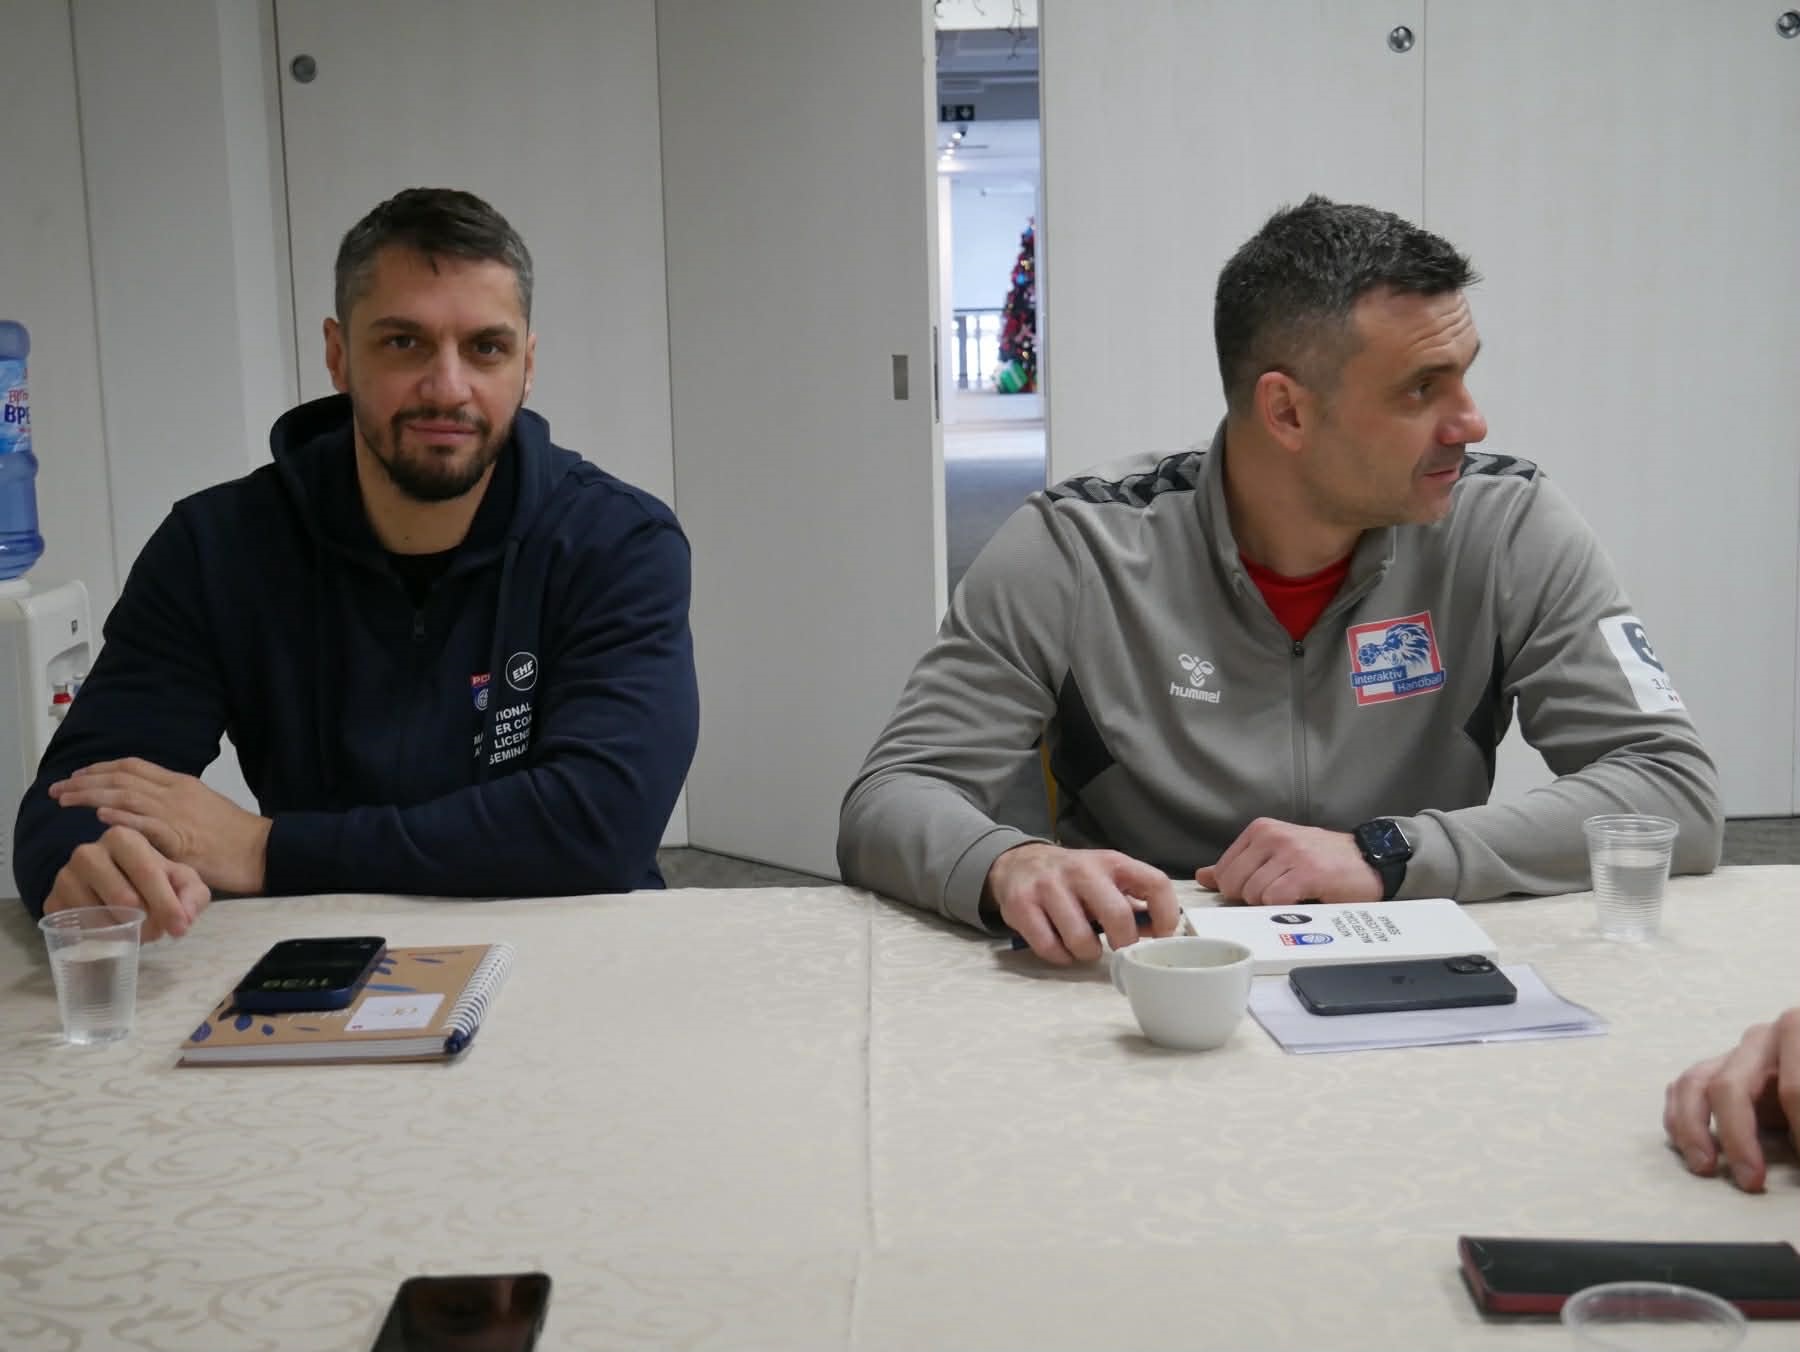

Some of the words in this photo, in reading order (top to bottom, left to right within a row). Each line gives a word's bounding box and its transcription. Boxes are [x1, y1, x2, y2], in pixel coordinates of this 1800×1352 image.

[512, 660, 534, 680] EHF
[1354, 670, 1404, 685] interaktiv
[1397, 673, 1443, 691] Handball
[1169, 681, 1221, 704] hummel
